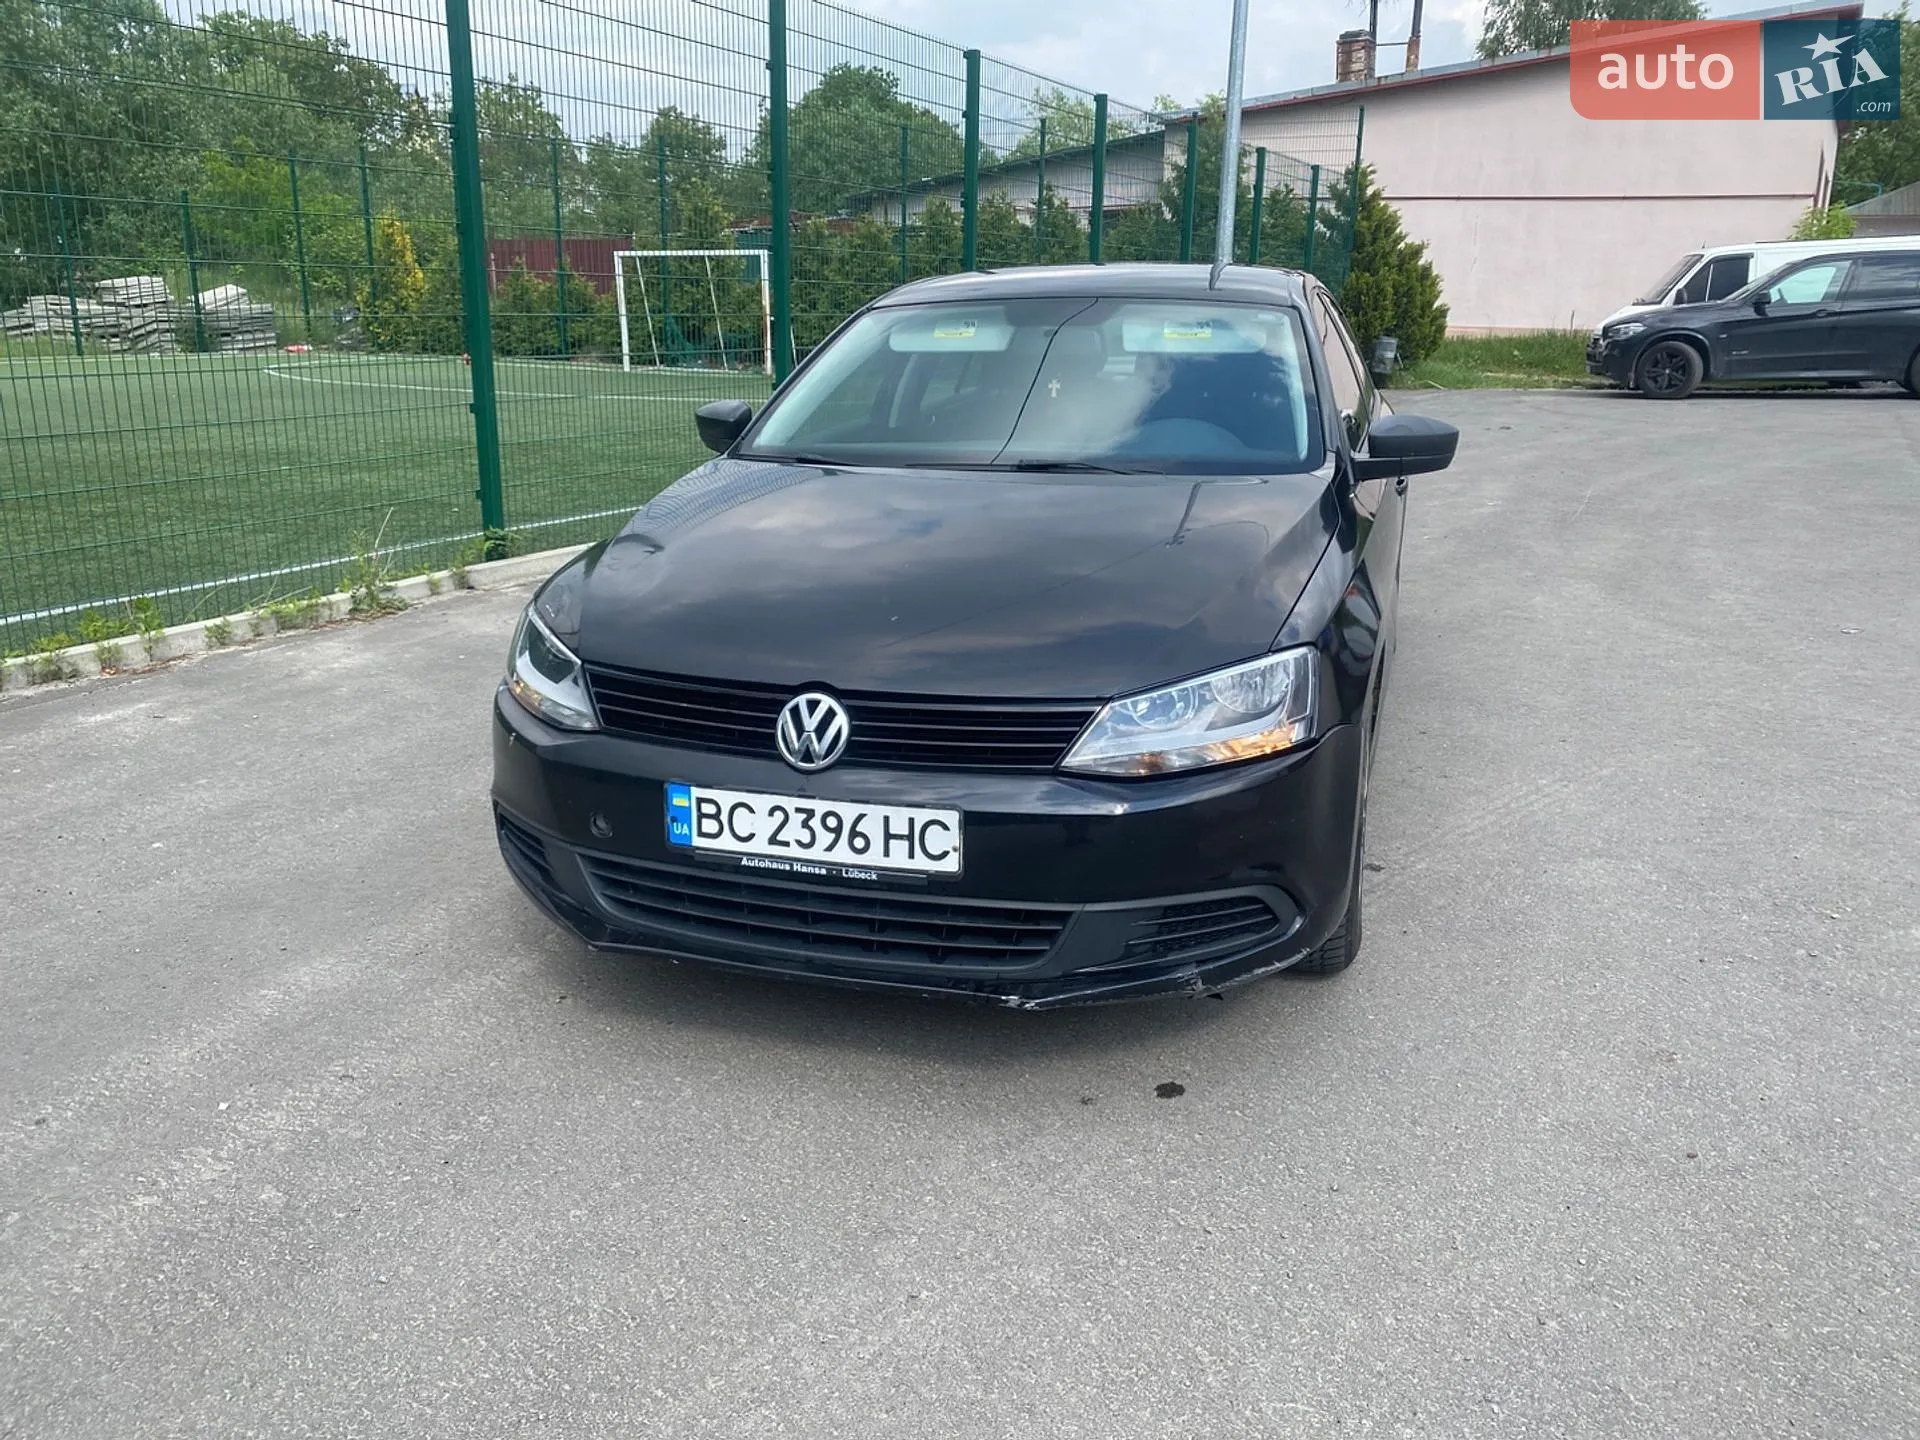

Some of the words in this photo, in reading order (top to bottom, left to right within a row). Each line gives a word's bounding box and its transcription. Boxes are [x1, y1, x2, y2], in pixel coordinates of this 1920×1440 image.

[673, 822, 690, 836] UA
[695, 796, 756, 843] BC
[767, 804, 871, 855] 2396
[882, 814, 951, 861] HC
[741, 856, 791, 871] Autohaus
[793, 862, 827, 875] Hansa
[841, 867, 879, 880] Lübeck
